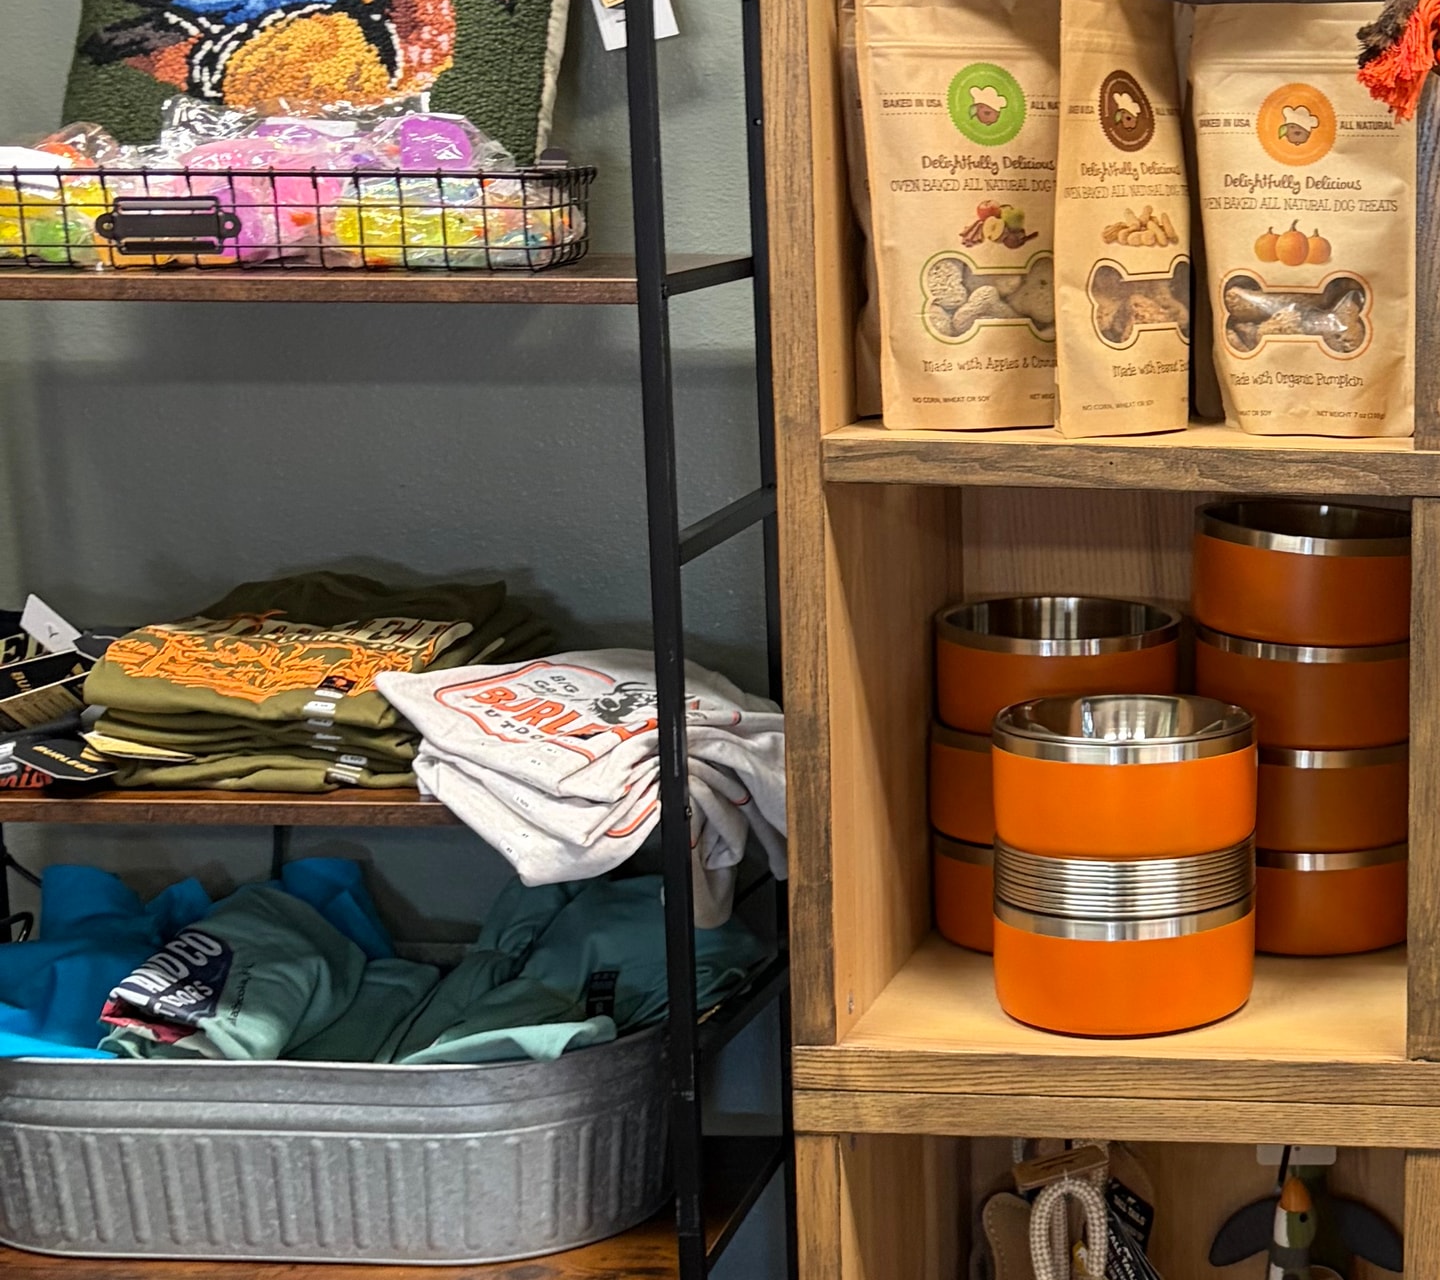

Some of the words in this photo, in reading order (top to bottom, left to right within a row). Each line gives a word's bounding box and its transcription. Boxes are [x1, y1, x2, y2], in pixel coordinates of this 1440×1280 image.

[882, 98, 913, 109] BAKED
[926, 99, 944, 108] USA
[1233, 119, 1251, 128] USA
[1339, 121, 1354, 130] ALL
[1356, 121, 1395, 130] NATURAL
[921, 154, 999, 175] Delightfully
[1002, 156, 1056, 171] Delicious
[962, 178, 984, 191] ALL
[984, 178, 1030, 192] NATURAL
[1031, 179, 1052, 192] DOG
[1224, 173, 1301, 195] Delightfully
[1305, 176, 1363, 191] Delicious
[1223, 197, 1258, 210] BAKED
[1260, 197, 1281, 210] ALL
[1283, 198, 1332, 212] NATURAL
[1333, 199, 1356, 212] DOG
[1358, 199, 1399, 212] TREATS
[956, 356, 983, 371] with
[1252, 371, 1274, 386] with
[1275, 371, 1314, 388] Organic
[1315, 372, 1364, 389] Pumpkin
[550, 674, 579, 693] BIG
